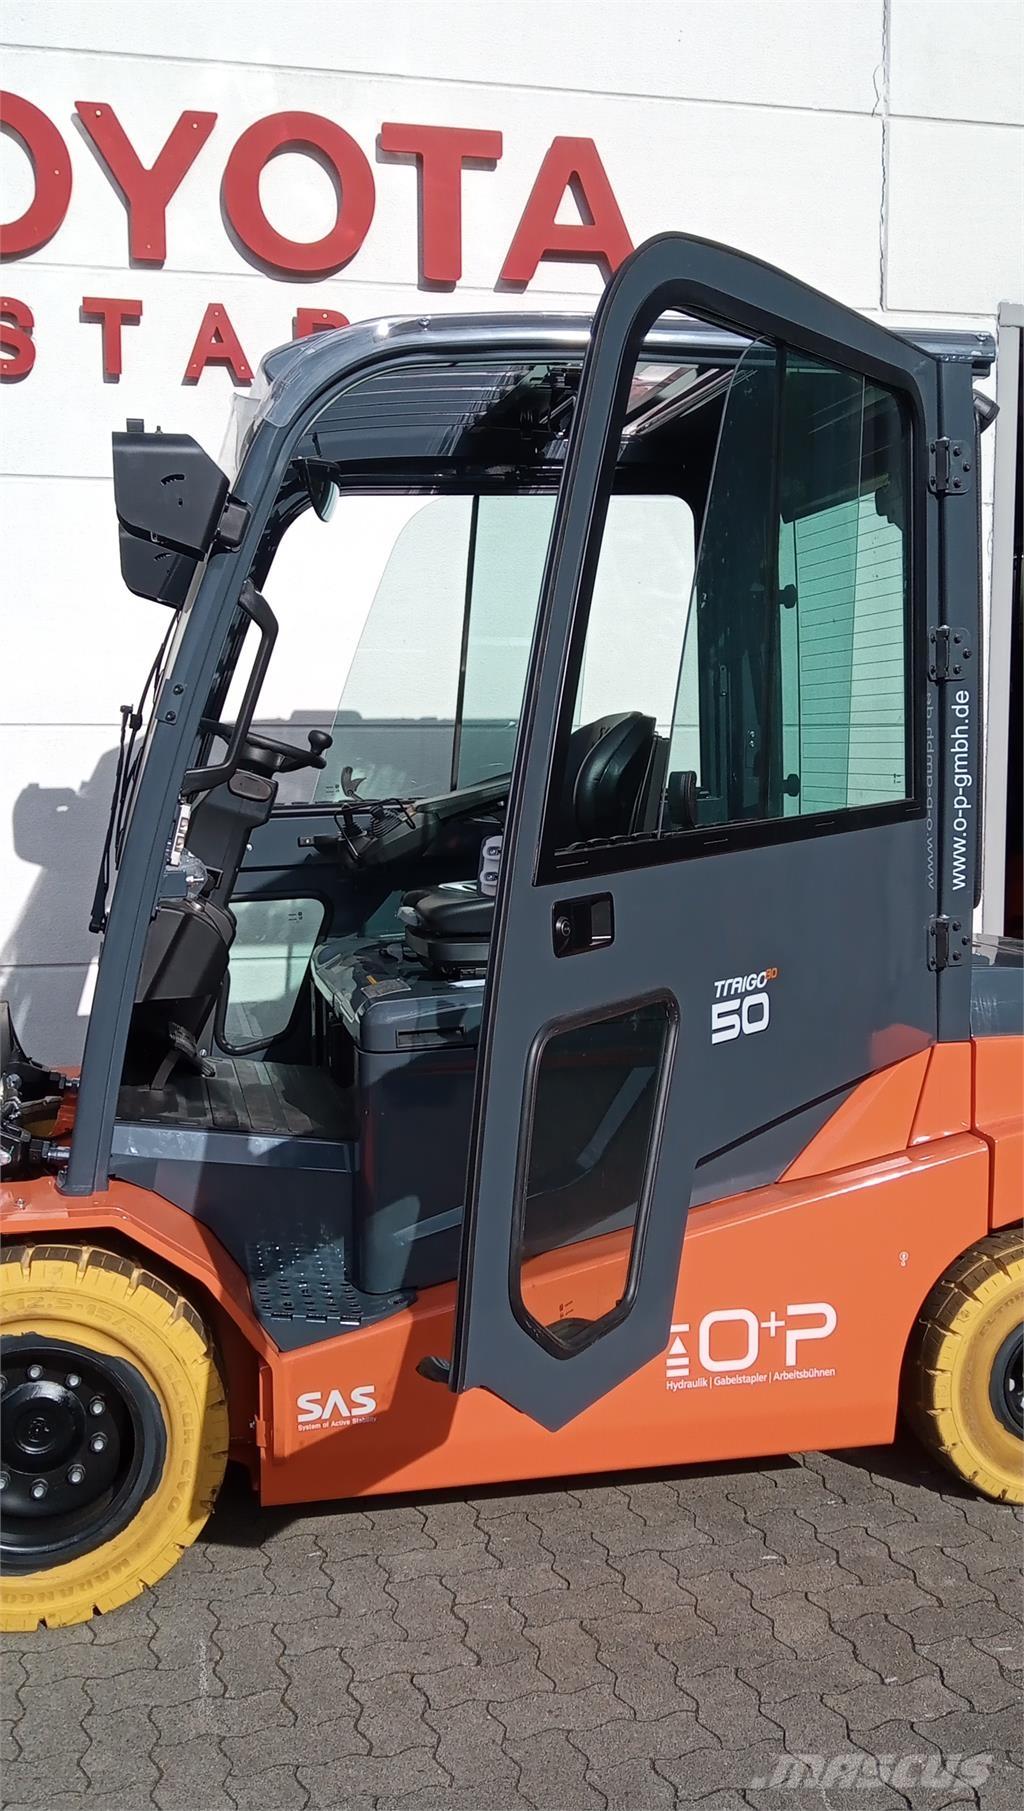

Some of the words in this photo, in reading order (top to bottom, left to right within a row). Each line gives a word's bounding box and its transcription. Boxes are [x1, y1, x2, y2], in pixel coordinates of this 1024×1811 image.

[951, 690, 972, 890] www.o-p-gmbh.de
[712, 992, 769, 1044] 50
[699, 1303, 837, 1373] O+P
[297, 1385, 376, 1422] SAS
[666, 1375, 708, 1391] Hydraulik
[714, 1373, 768, 1386] Gabelstapler
[773, 1367, 836, 1382] Arbeitsbühnen
